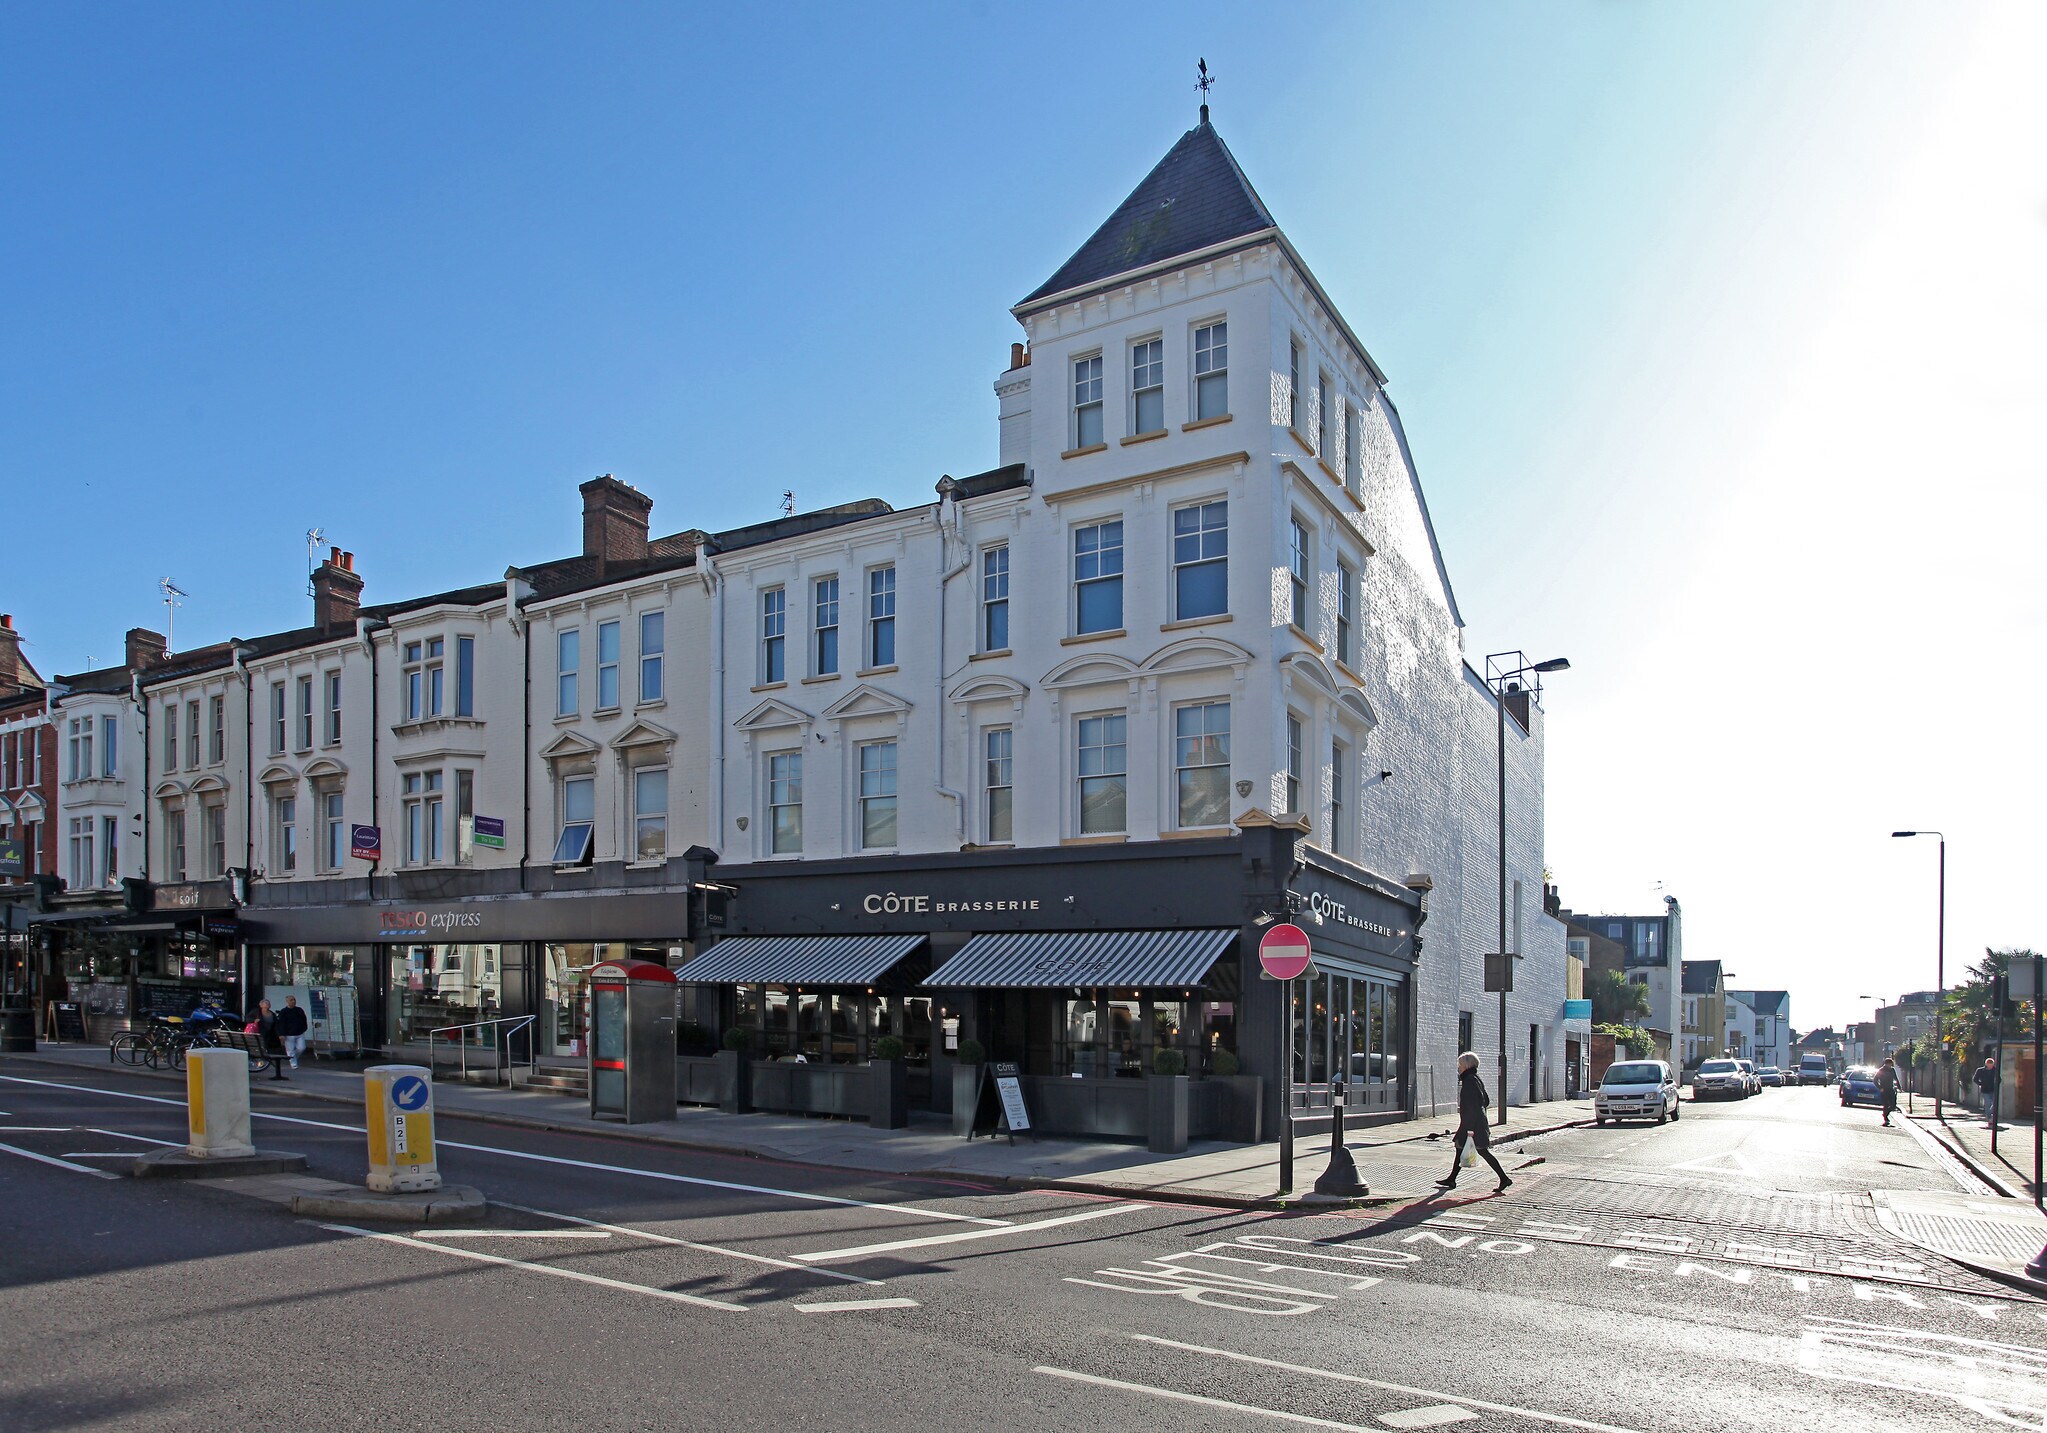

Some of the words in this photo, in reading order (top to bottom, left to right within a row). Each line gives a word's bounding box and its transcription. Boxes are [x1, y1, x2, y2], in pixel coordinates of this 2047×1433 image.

[179, 891, 200, 905] soif
[863, 891, 930, 914] CÔTE
[936, 900, 1040, 913] BRASSERIE
[378, 911, 427, 928] TESCO
[430, 910, 481, 933] express
[1311, 891, 1346, 923] CÔTE
[1347, 915, 1391, 937] BRASSERIE
[997, 1062, 1016, 1072] CÔTE
[1401, 1231, 1536, 1255] NO
[1607, 1254, 2013, 1321] ENTRY
